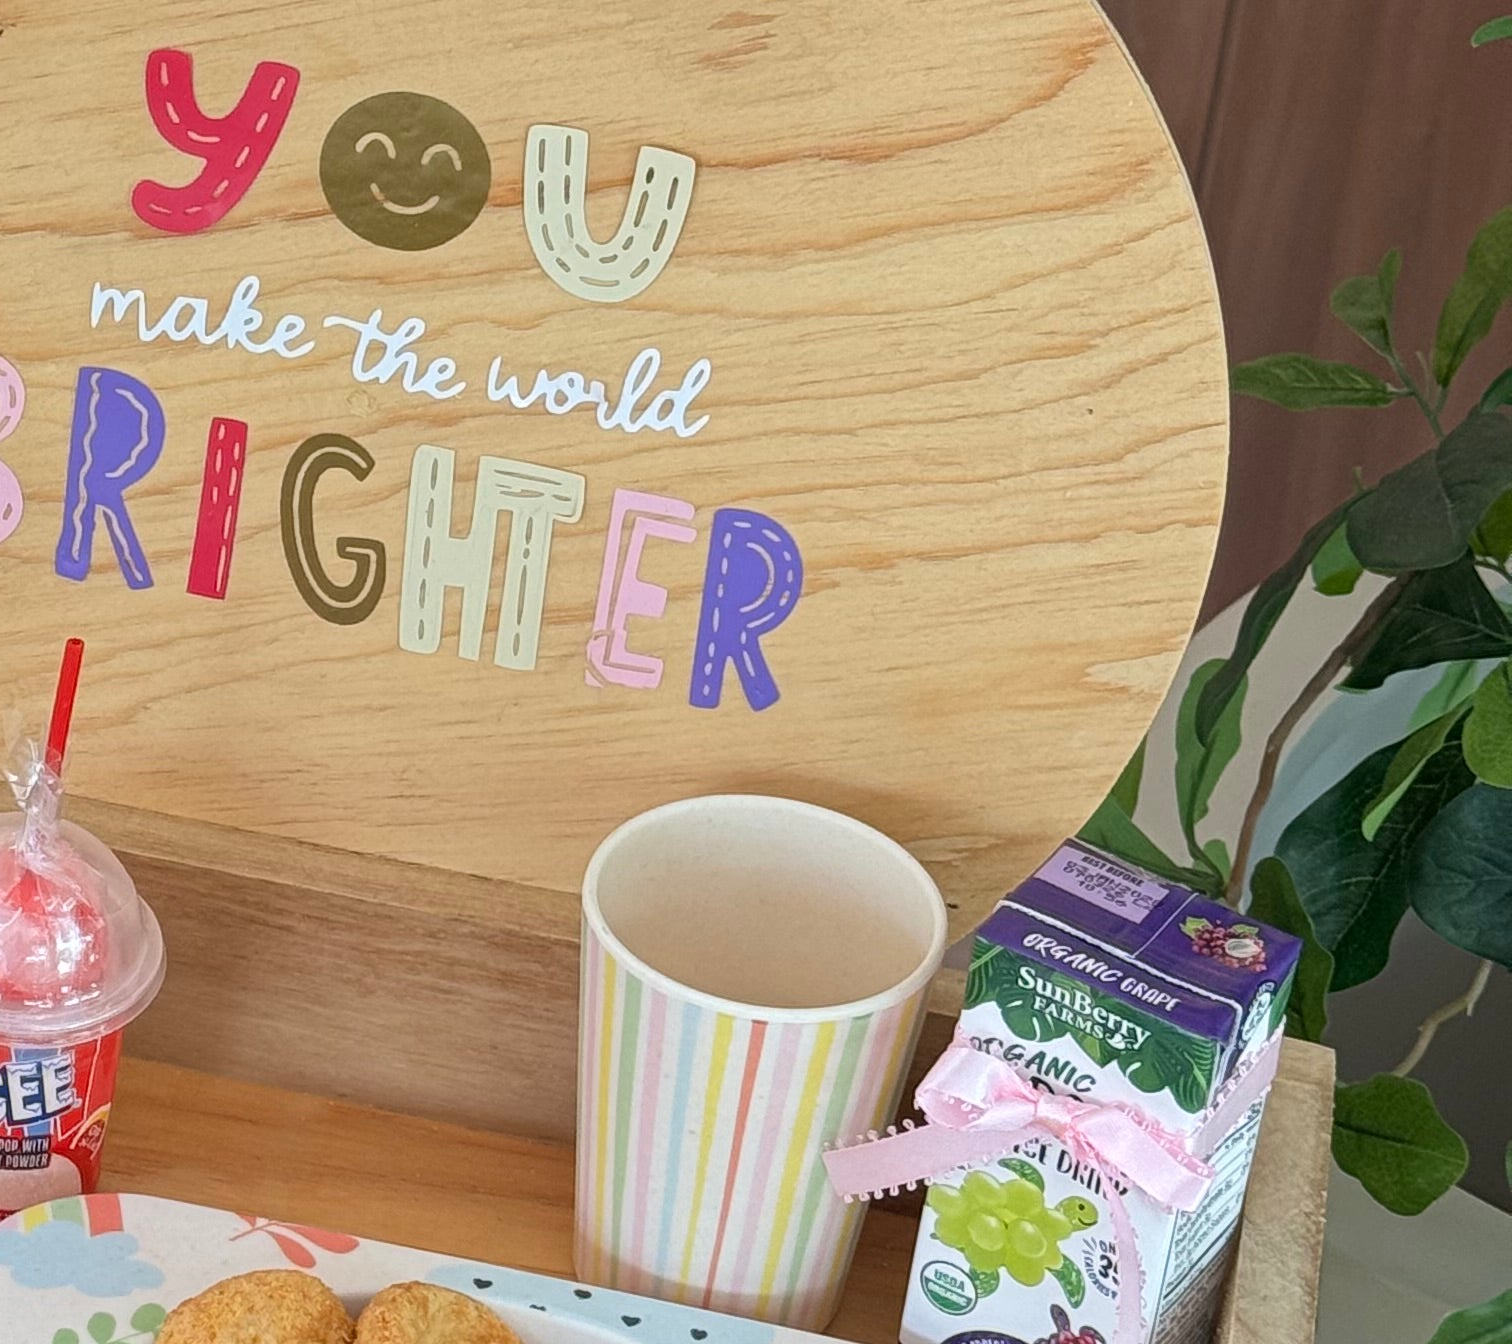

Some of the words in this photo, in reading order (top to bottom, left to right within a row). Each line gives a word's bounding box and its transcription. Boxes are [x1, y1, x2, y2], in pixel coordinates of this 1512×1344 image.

[90, 275, 315, 358] make
[323, 308, 467, 399] the
[488, 347, 712, 437] world
[1022, 932, 1124, 983] ORGANIC
[1119, 976, 1183, 1012] GRAPE
[1016, 965, 1152, 1051] SunBerry
[1032, 995, 1105, 1041] FARMS
[5, 1152, 49, 1169] POWDER
[22, 1137, 50, 1154] WITH
[934, 1268, 965, 1293] USDA
